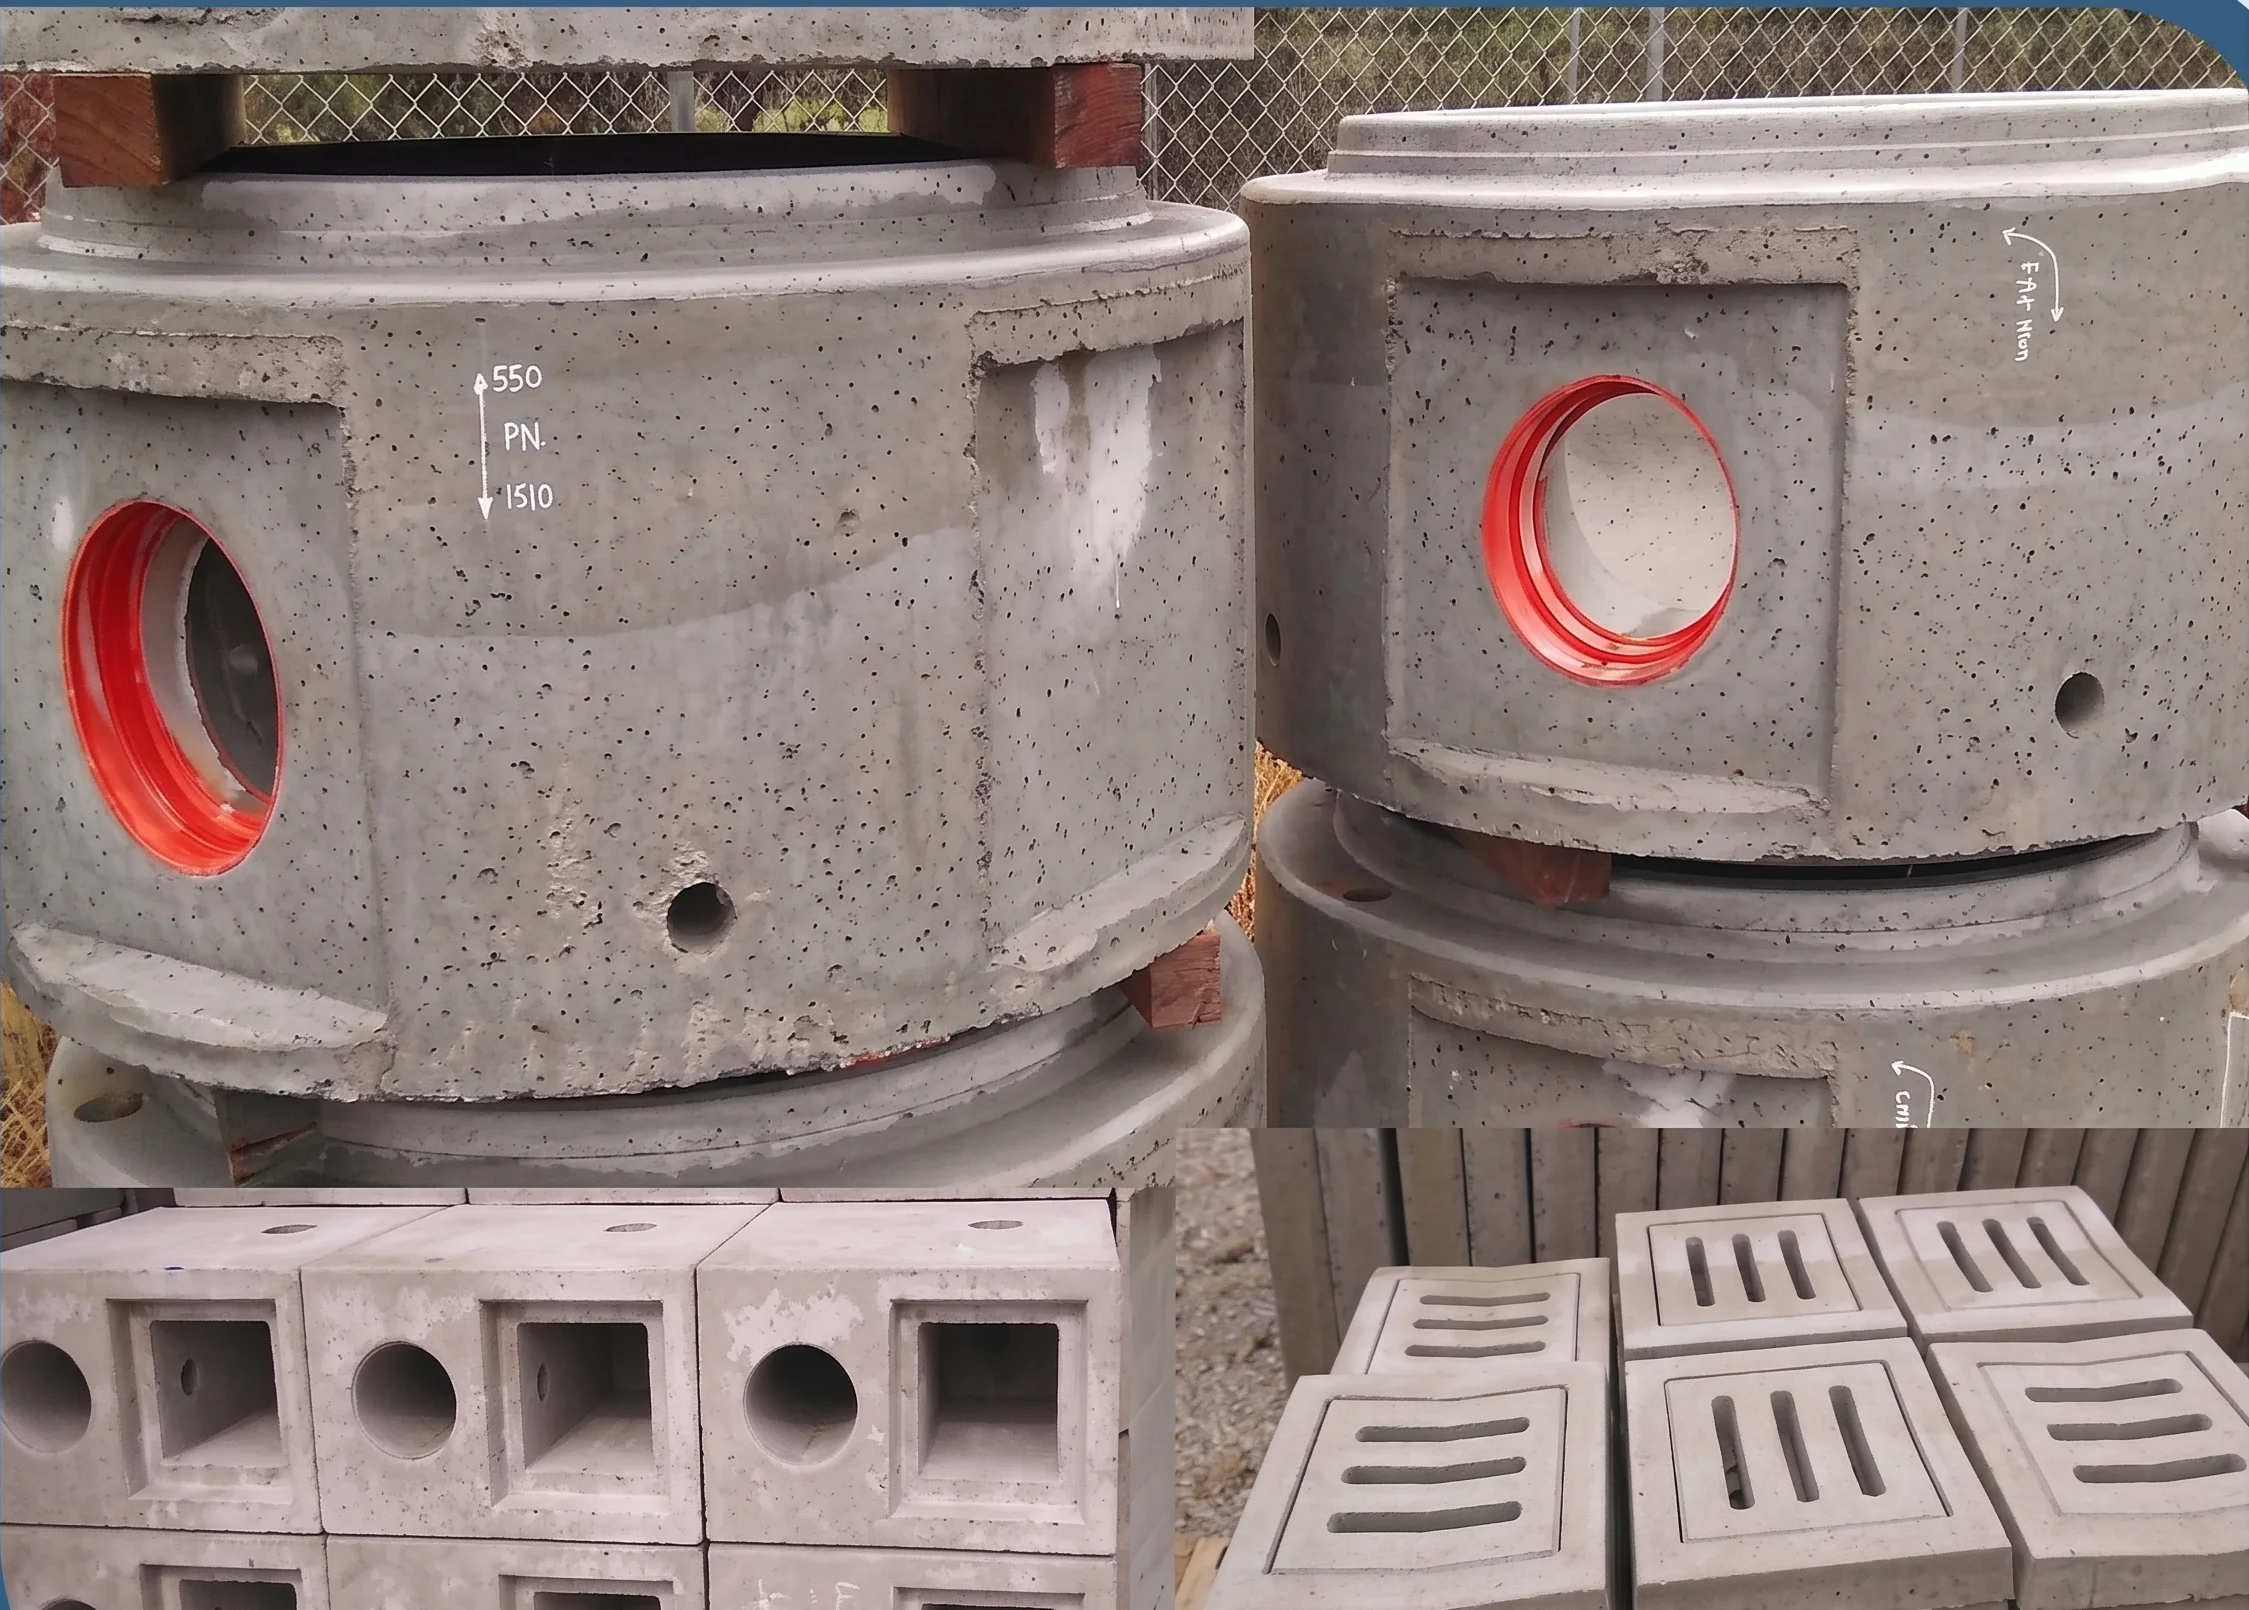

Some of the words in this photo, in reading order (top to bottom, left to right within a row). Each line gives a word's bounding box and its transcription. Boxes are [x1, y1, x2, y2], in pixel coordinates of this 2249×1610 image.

[492, 364, 543, 393] 550
[503, 421, 547, 452] PN.
[506, 482, 554, 512] 1510
